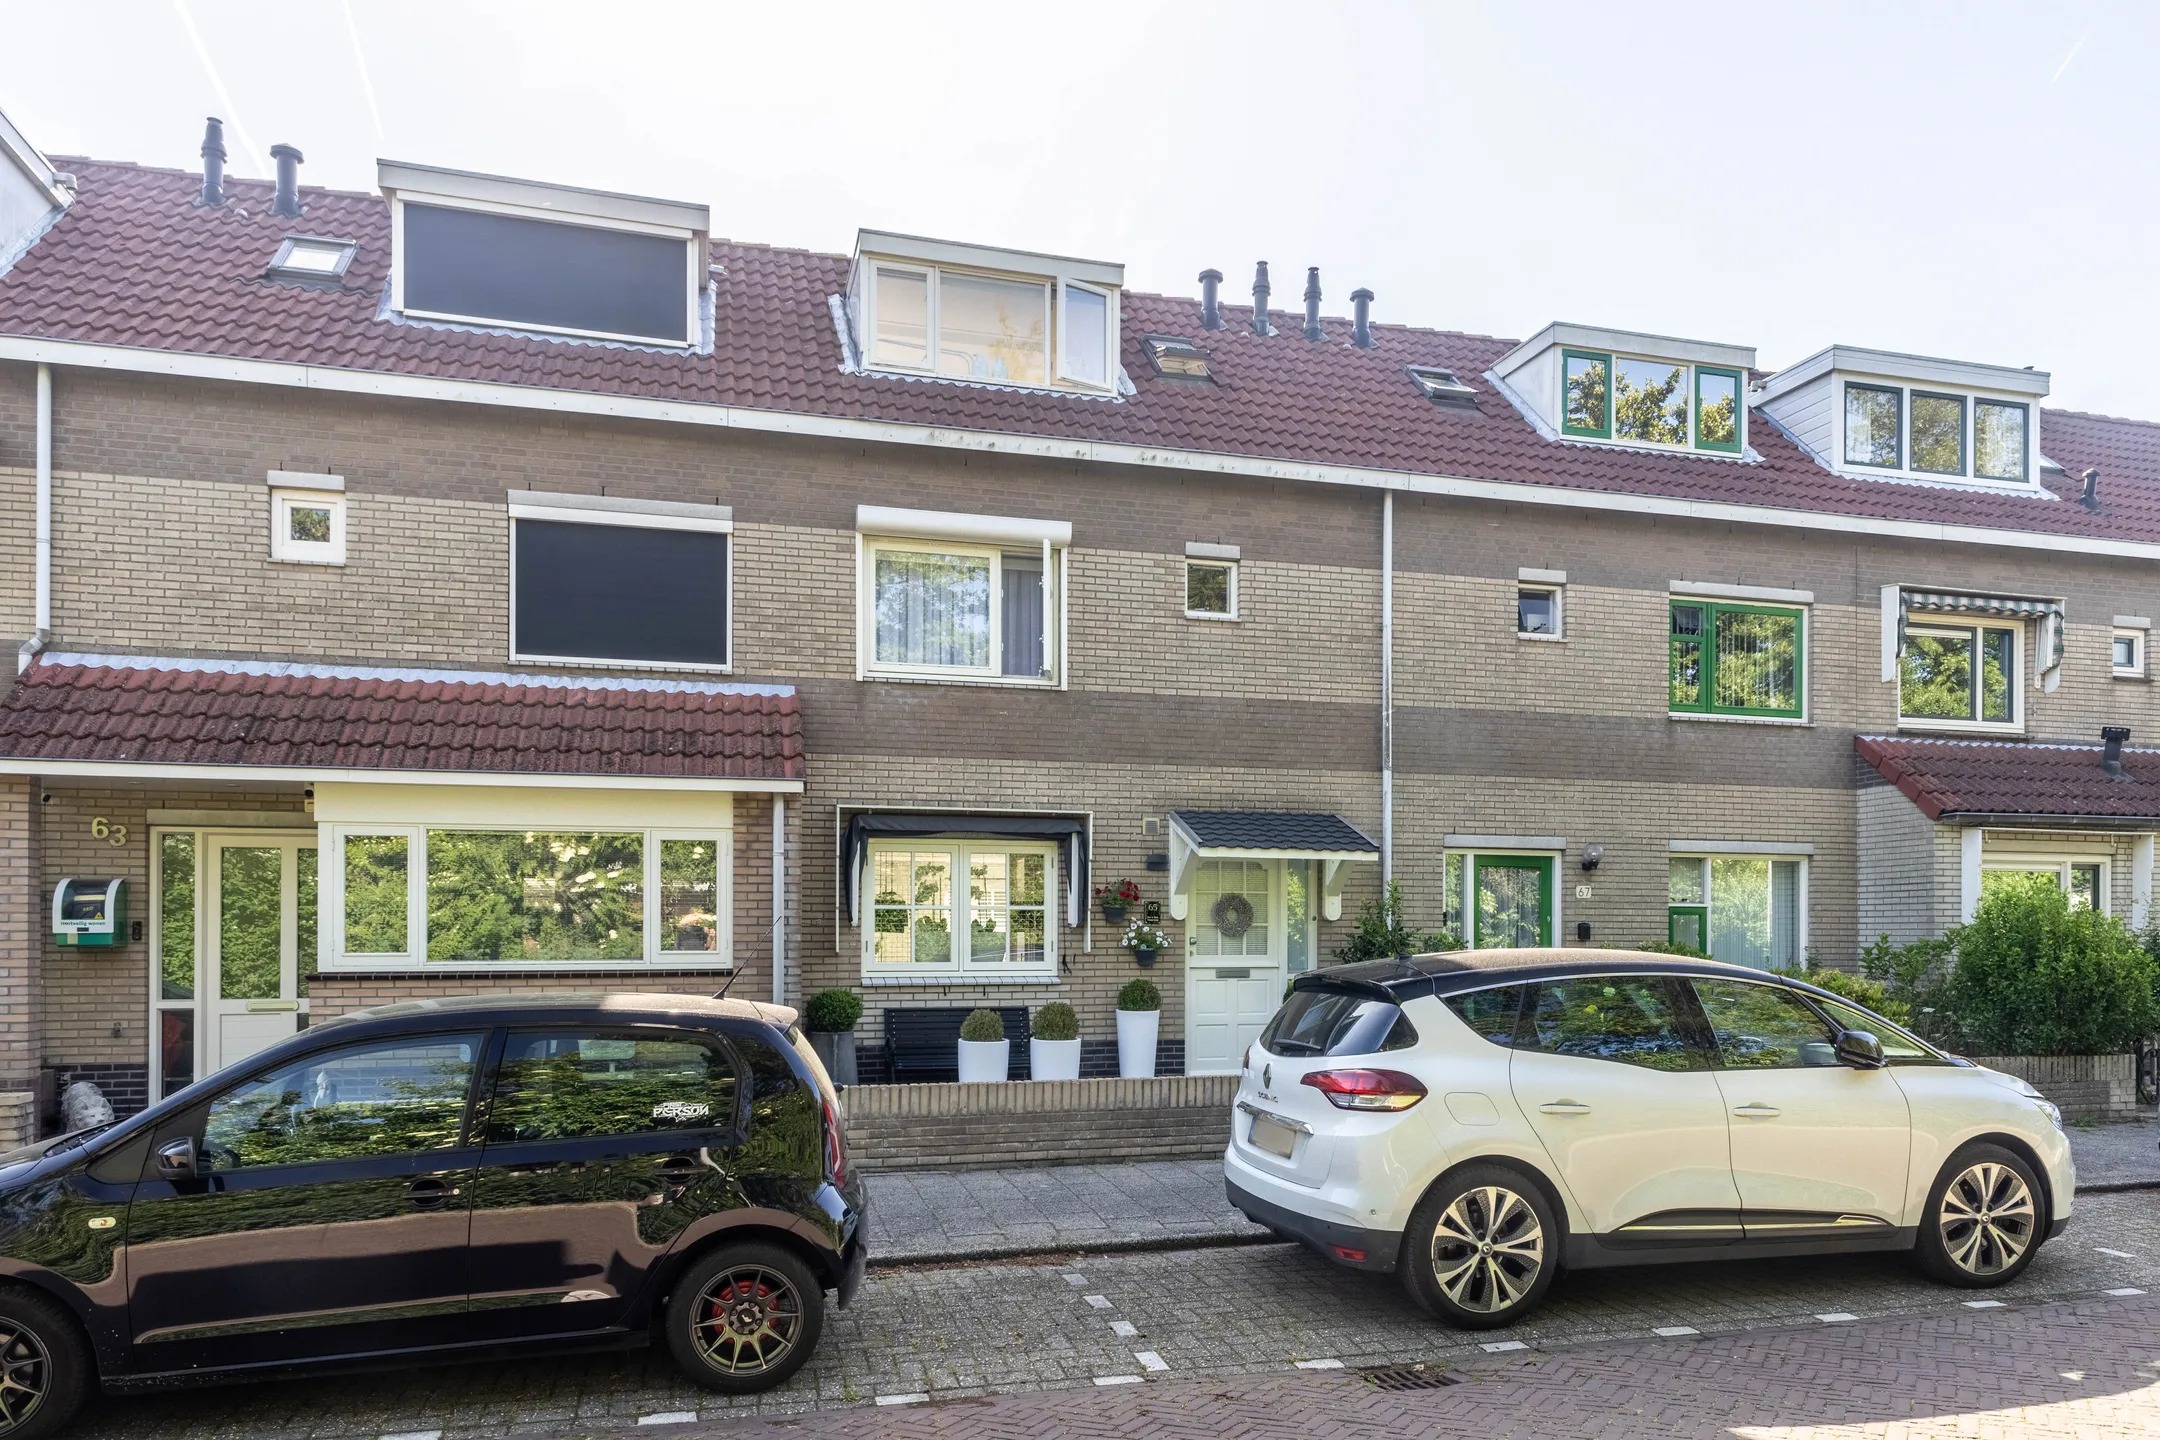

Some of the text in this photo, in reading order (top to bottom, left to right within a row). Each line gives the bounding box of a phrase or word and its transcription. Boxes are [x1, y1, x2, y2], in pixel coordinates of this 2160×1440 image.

[91, 816, 127, 847] 63
[1577, 886, 1591, 897] 67
[1148, 903, 1158, 911] 65
[653, 1105, 709, 1118] PERSON
